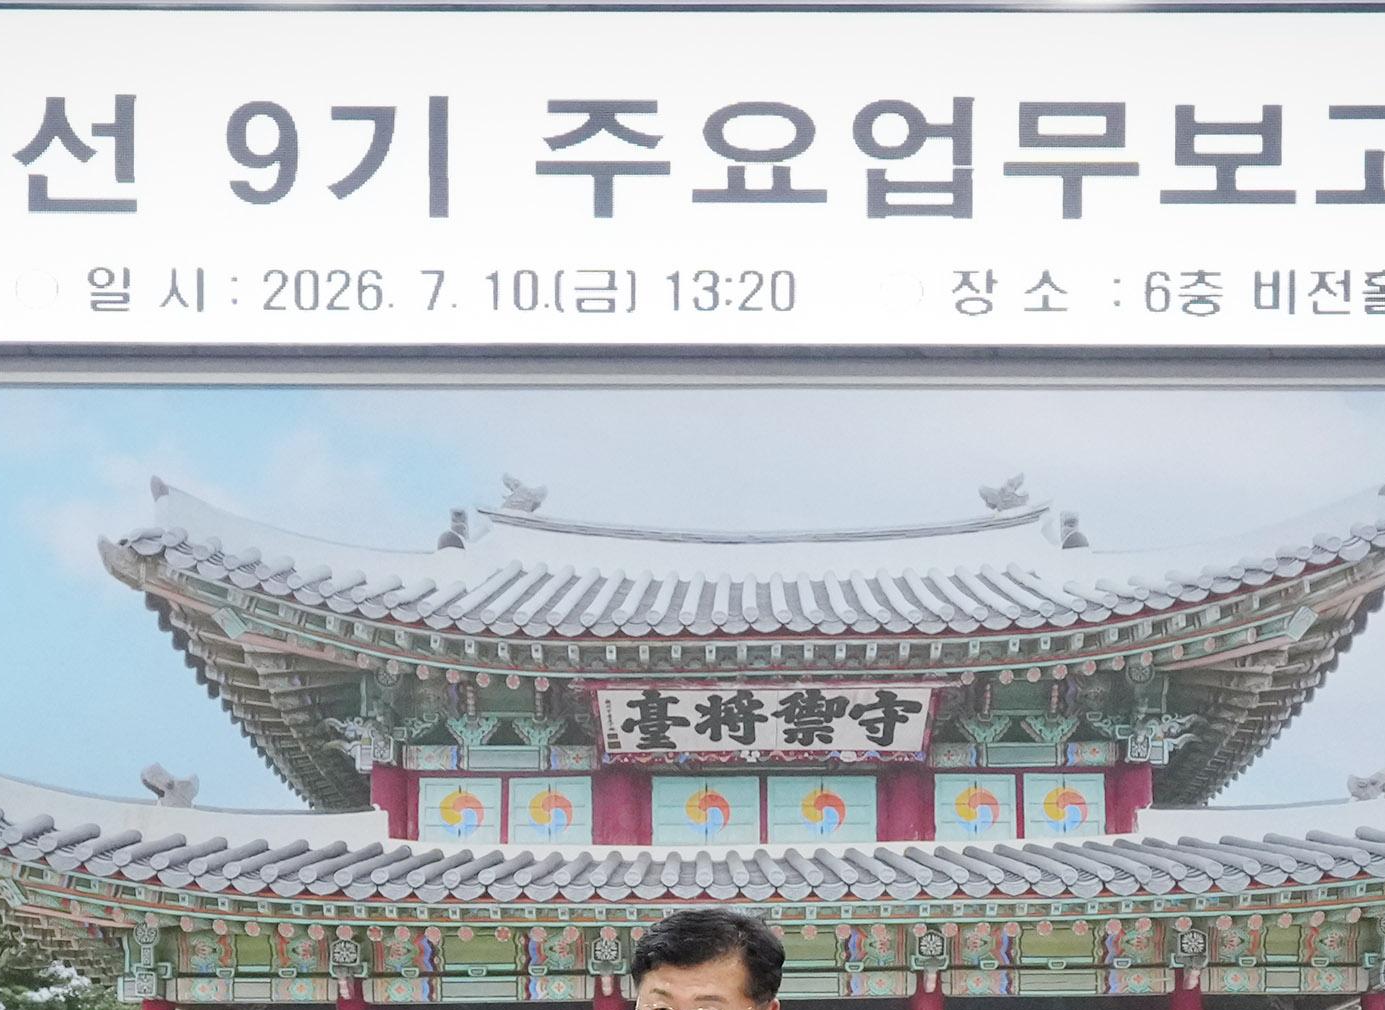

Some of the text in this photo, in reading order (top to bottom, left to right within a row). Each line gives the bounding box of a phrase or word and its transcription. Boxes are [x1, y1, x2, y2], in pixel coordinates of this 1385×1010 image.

[226, 96, 448, 216] 9기
[262, 269, 395, 312] 2026.
[421, 270, 458, 311] 7.
[486, 269, 638, 314] 10.(금)
[666, 270, 797, 312] 13:20
[1144, 269, 1224, 317] 6층
